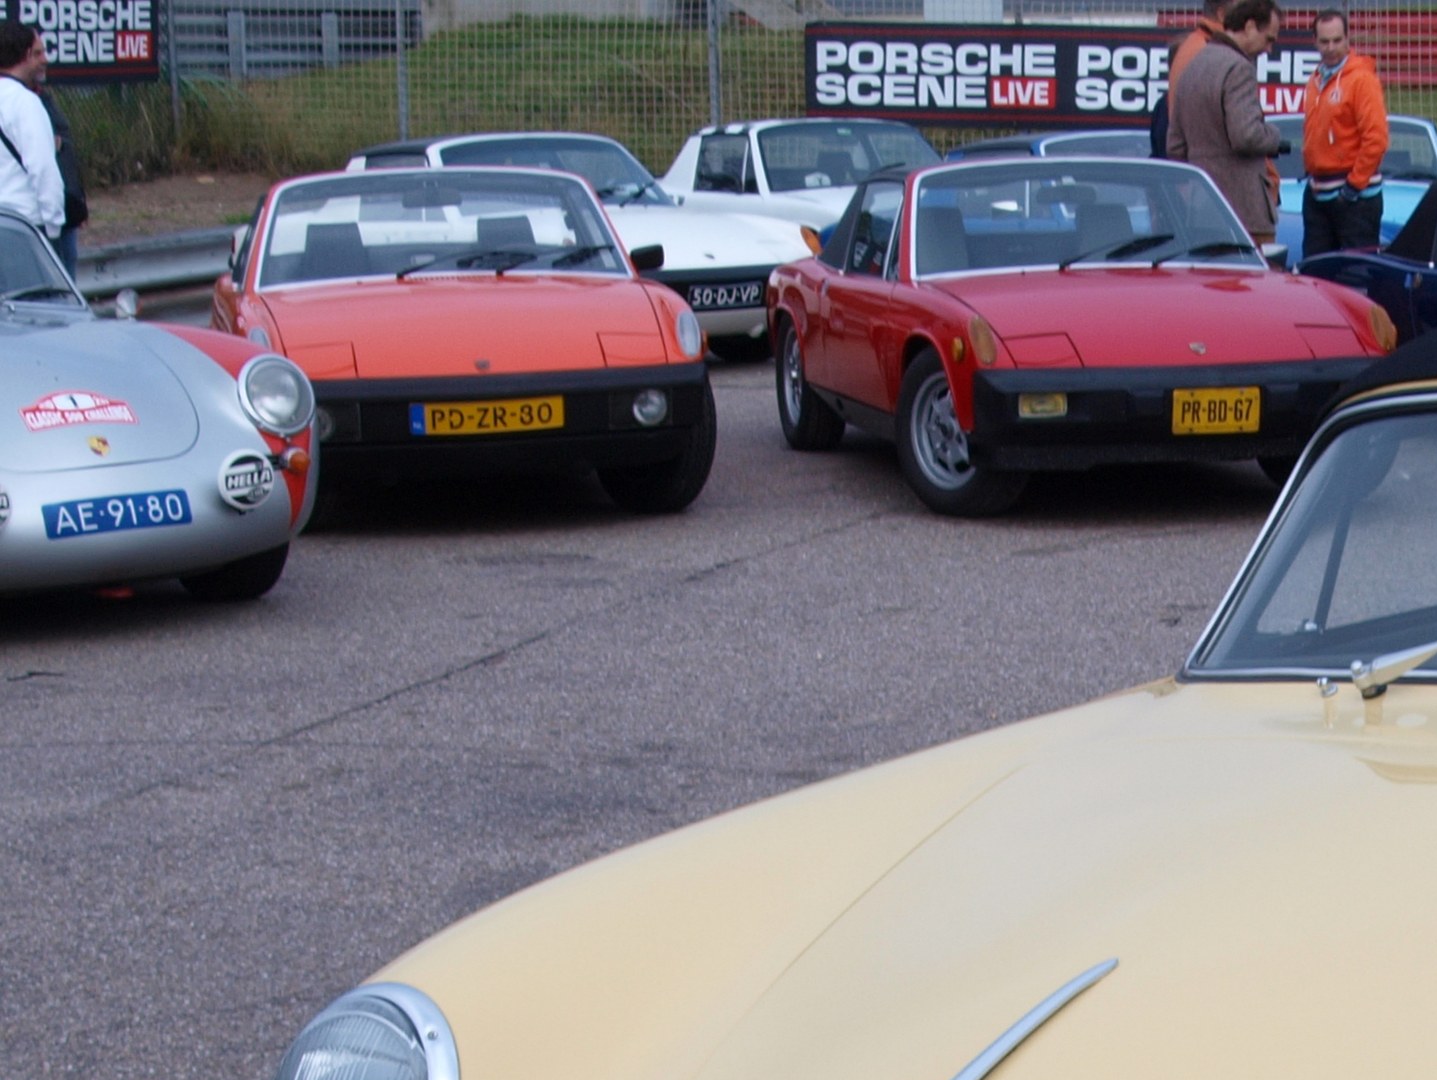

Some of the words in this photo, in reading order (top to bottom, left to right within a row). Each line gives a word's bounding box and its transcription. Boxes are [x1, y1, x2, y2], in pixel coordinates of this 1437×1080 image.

[19, 0, 151, 30] PORSCHE
[41, 31, 114, 62] CENE
[117, 34, 148, 58] LIVE
[816, 41, 1056, 76] PORSCHE
[815, 73, 987, 107] SCENE
[993, 80, 1049, 105] LIVE
[1259, 87, 1306, 112] LIV
[227, 468, 272, 489] HELLA
